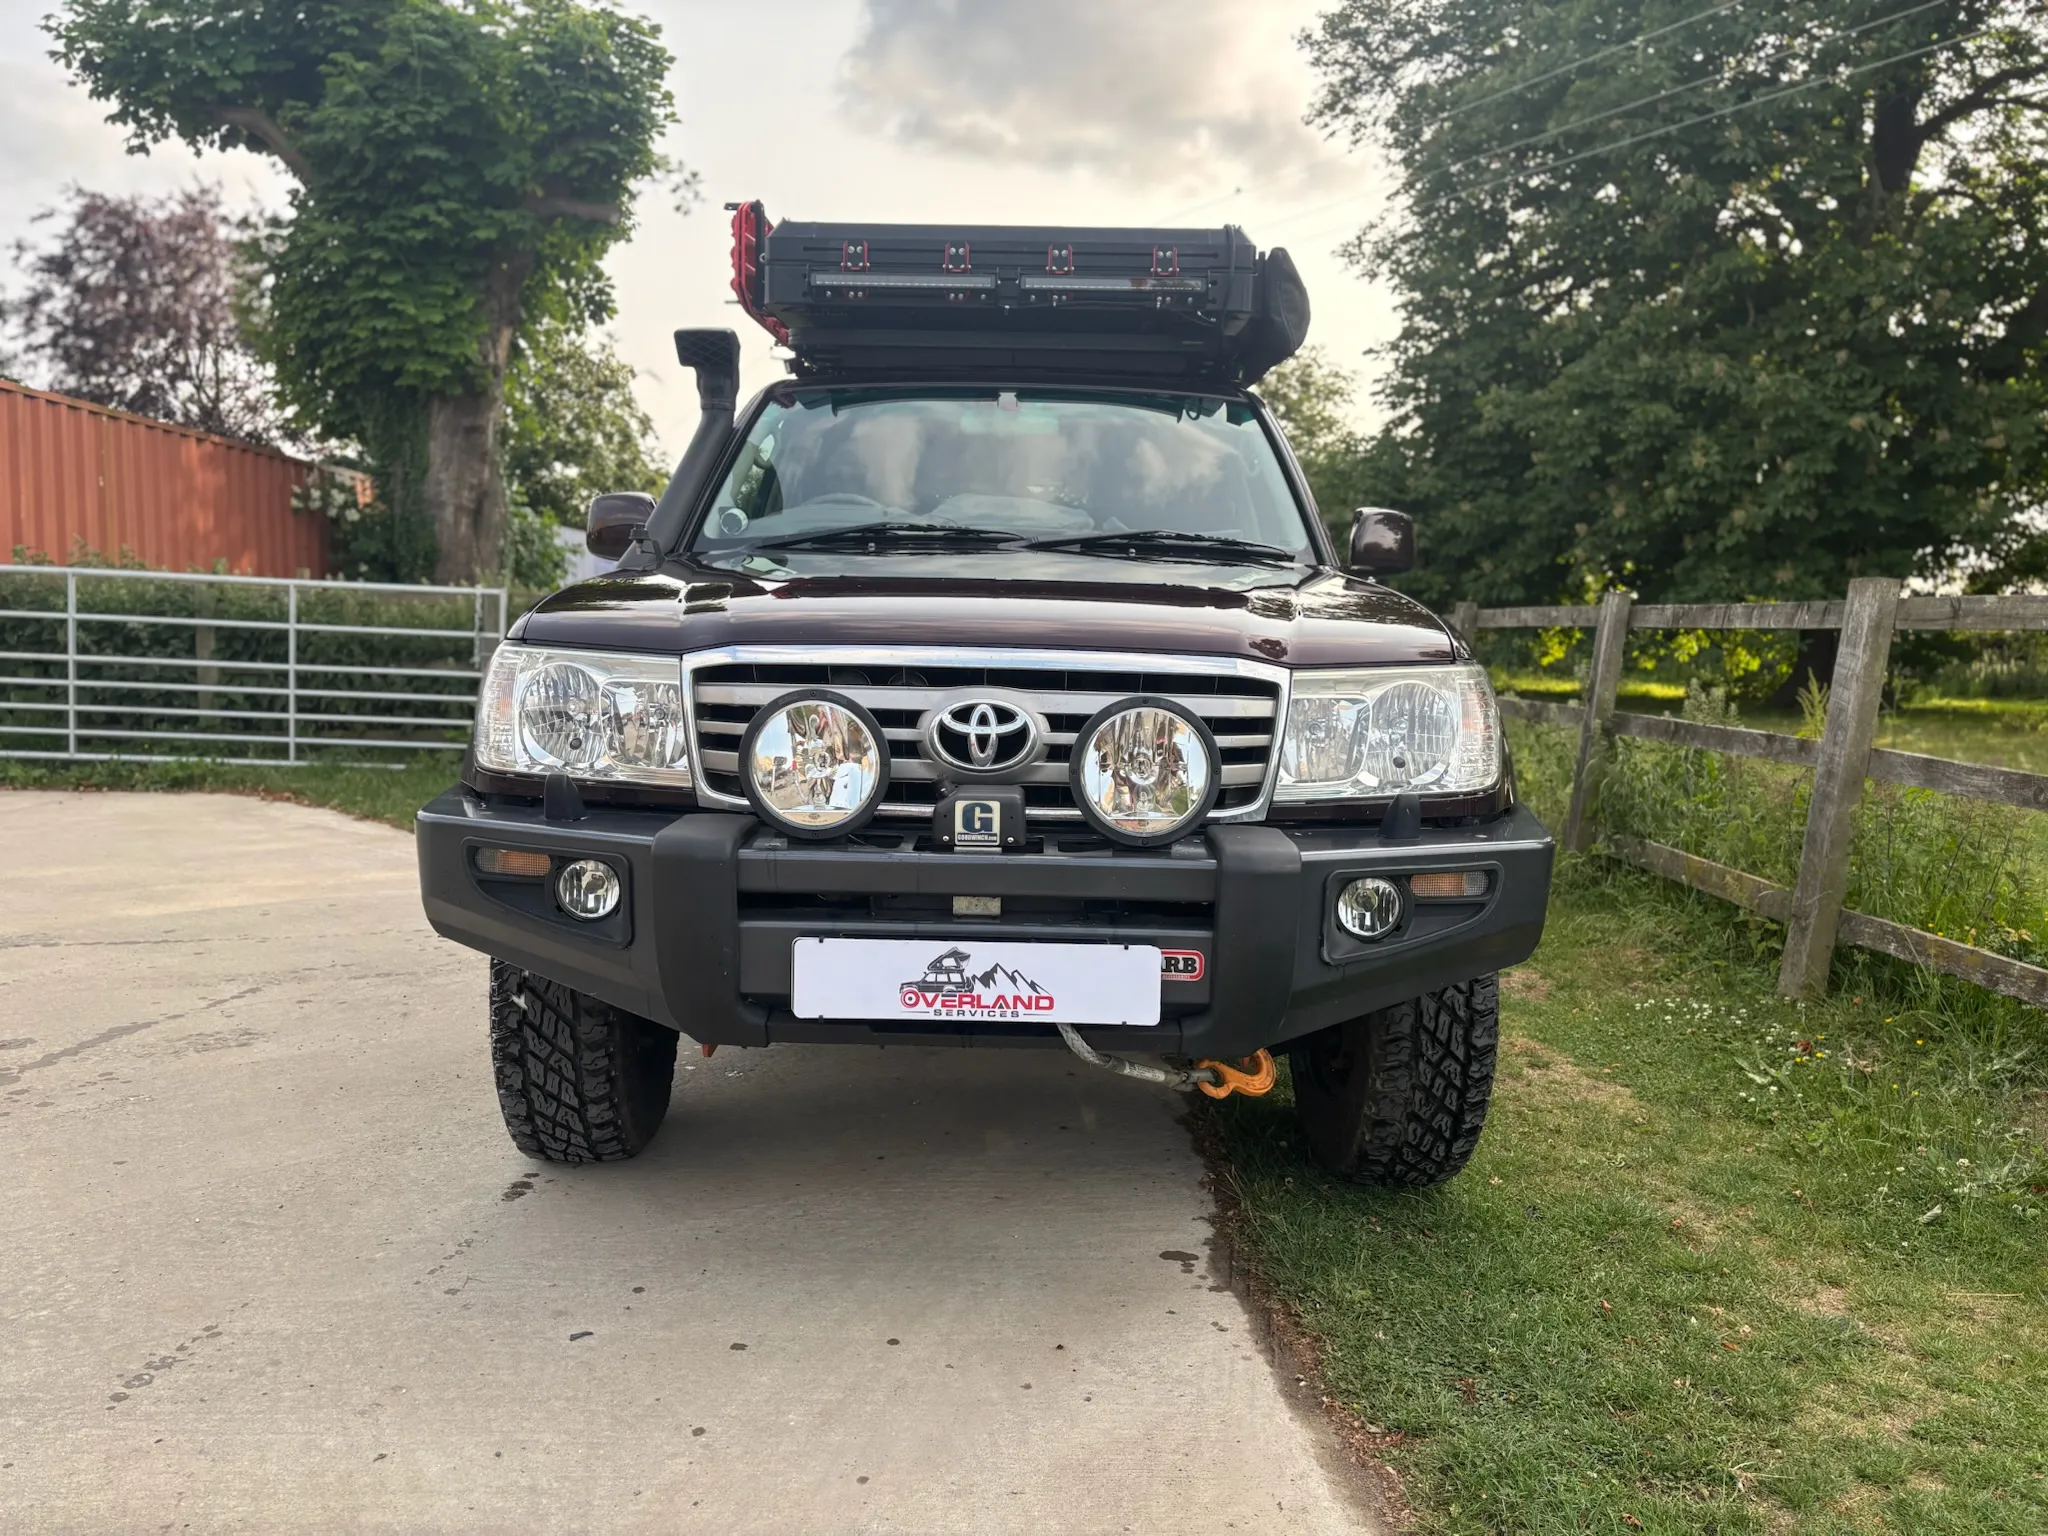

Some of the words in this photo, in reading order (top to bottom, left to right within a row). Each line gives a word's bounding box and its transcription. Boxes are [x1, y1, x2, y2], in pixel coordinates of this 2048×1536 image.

[962, 803, 993, 833] G
[1161, 956, 1197, 973] RB
[901, 989, 1055, 1011] OVERLAND
[933, 1009, 1020, 1018] SERVICES
